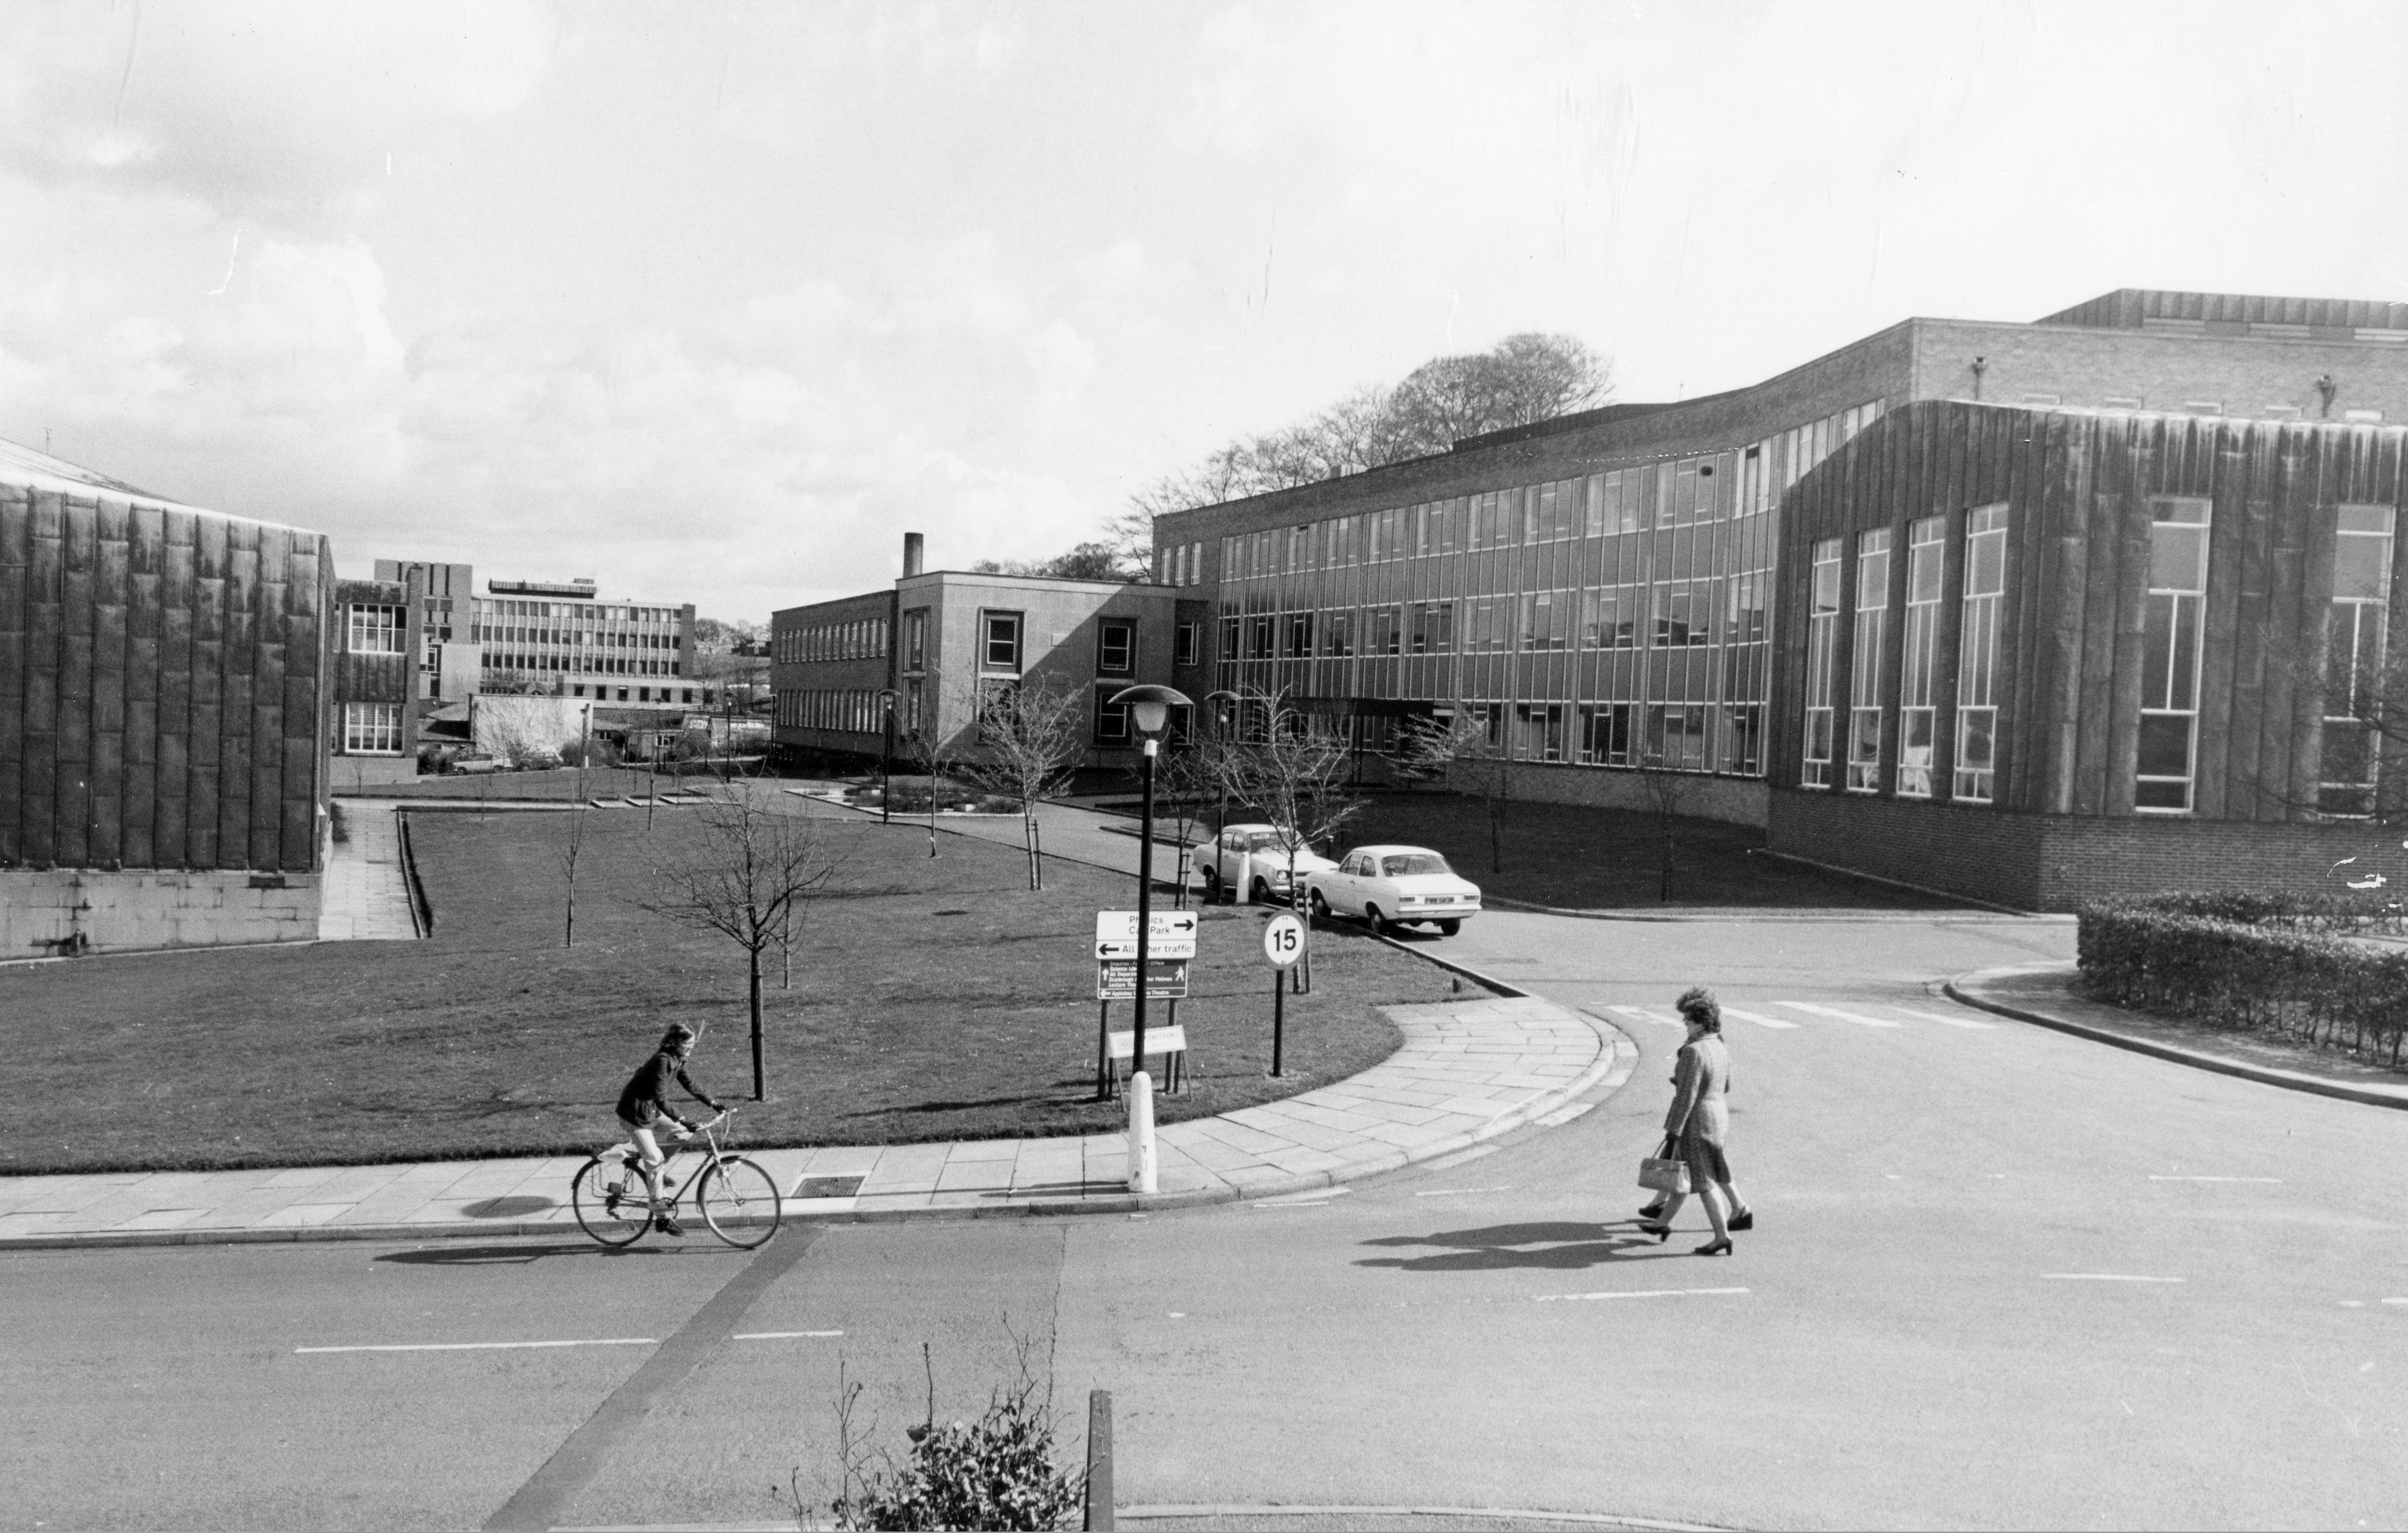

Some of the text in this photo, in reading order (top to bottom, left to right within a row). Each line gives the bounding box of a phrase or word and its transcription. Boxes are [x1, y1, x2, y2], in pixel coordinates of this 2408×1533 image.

[1150, 926, 1170, 934] Park
[1273, 929, 1296, 952] 15
[1164, 944, 1192, 953] traffic
